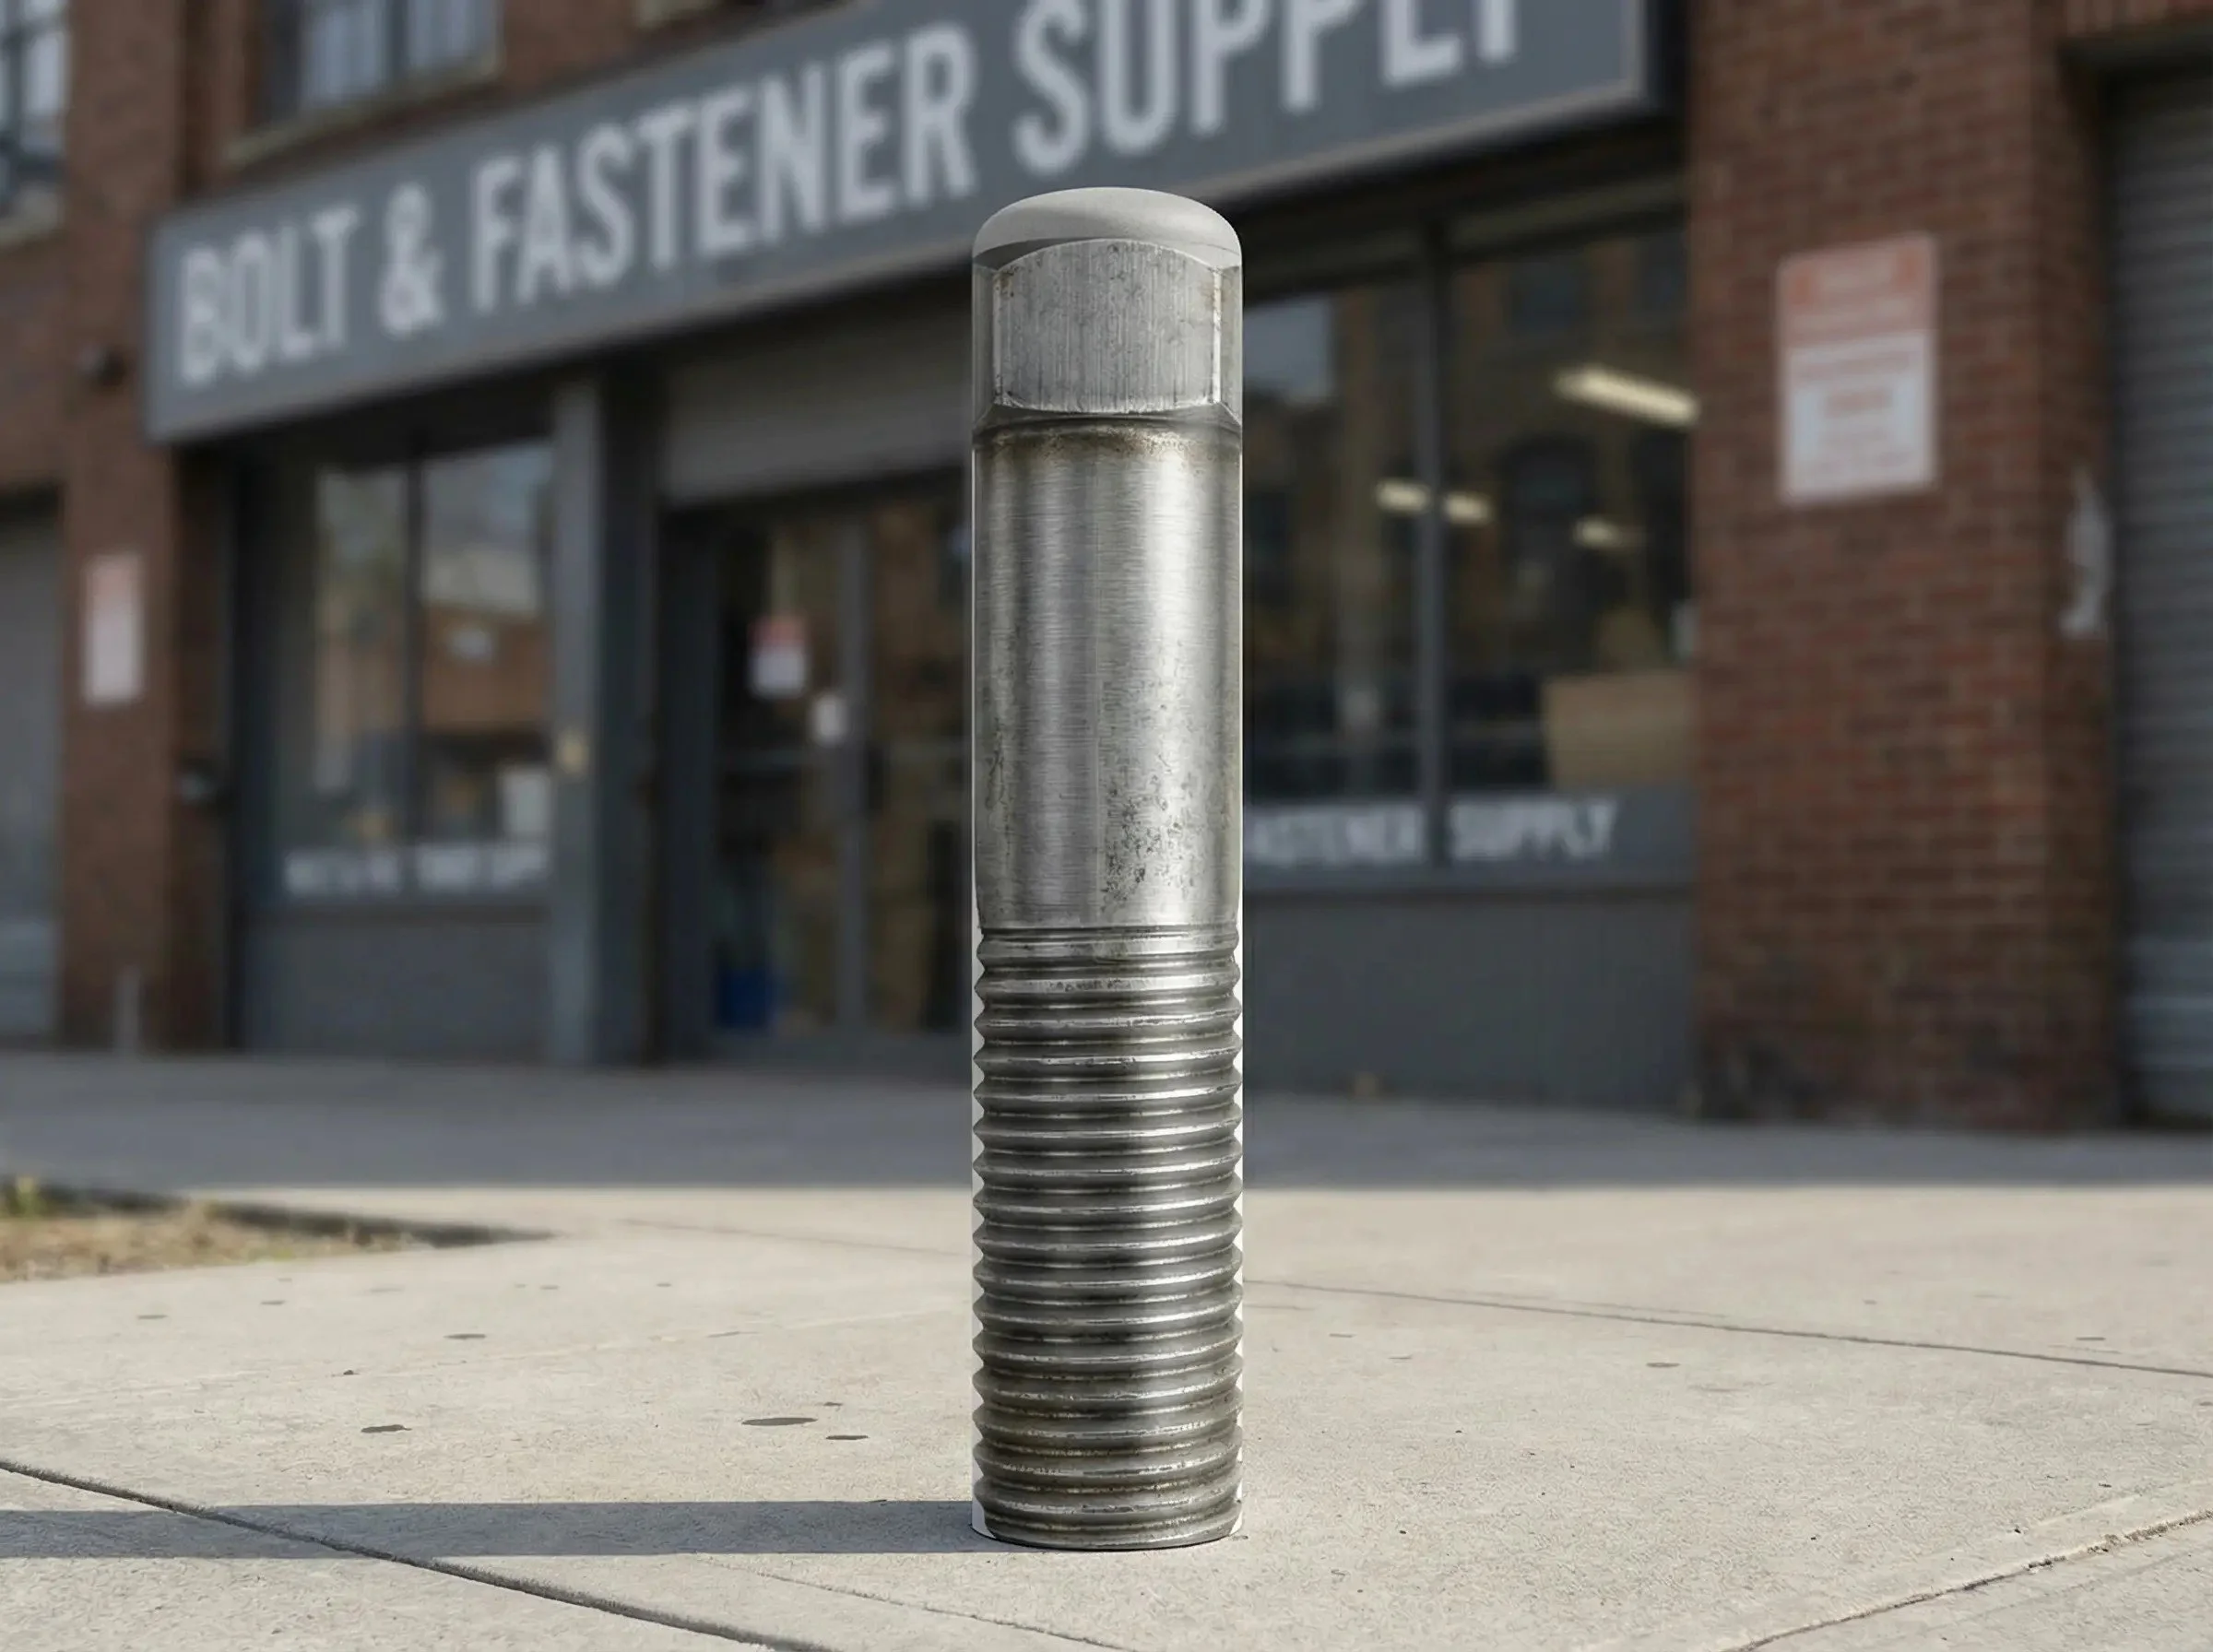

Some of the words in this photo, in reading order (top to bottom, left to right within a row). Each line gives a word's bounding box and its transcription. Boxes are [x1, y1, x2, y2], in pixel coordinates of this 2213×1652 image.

[178, 205, 360, 386] BOLT
[377, 183, 445, 336] &
[470, 24, 976, 313] FASTENER
